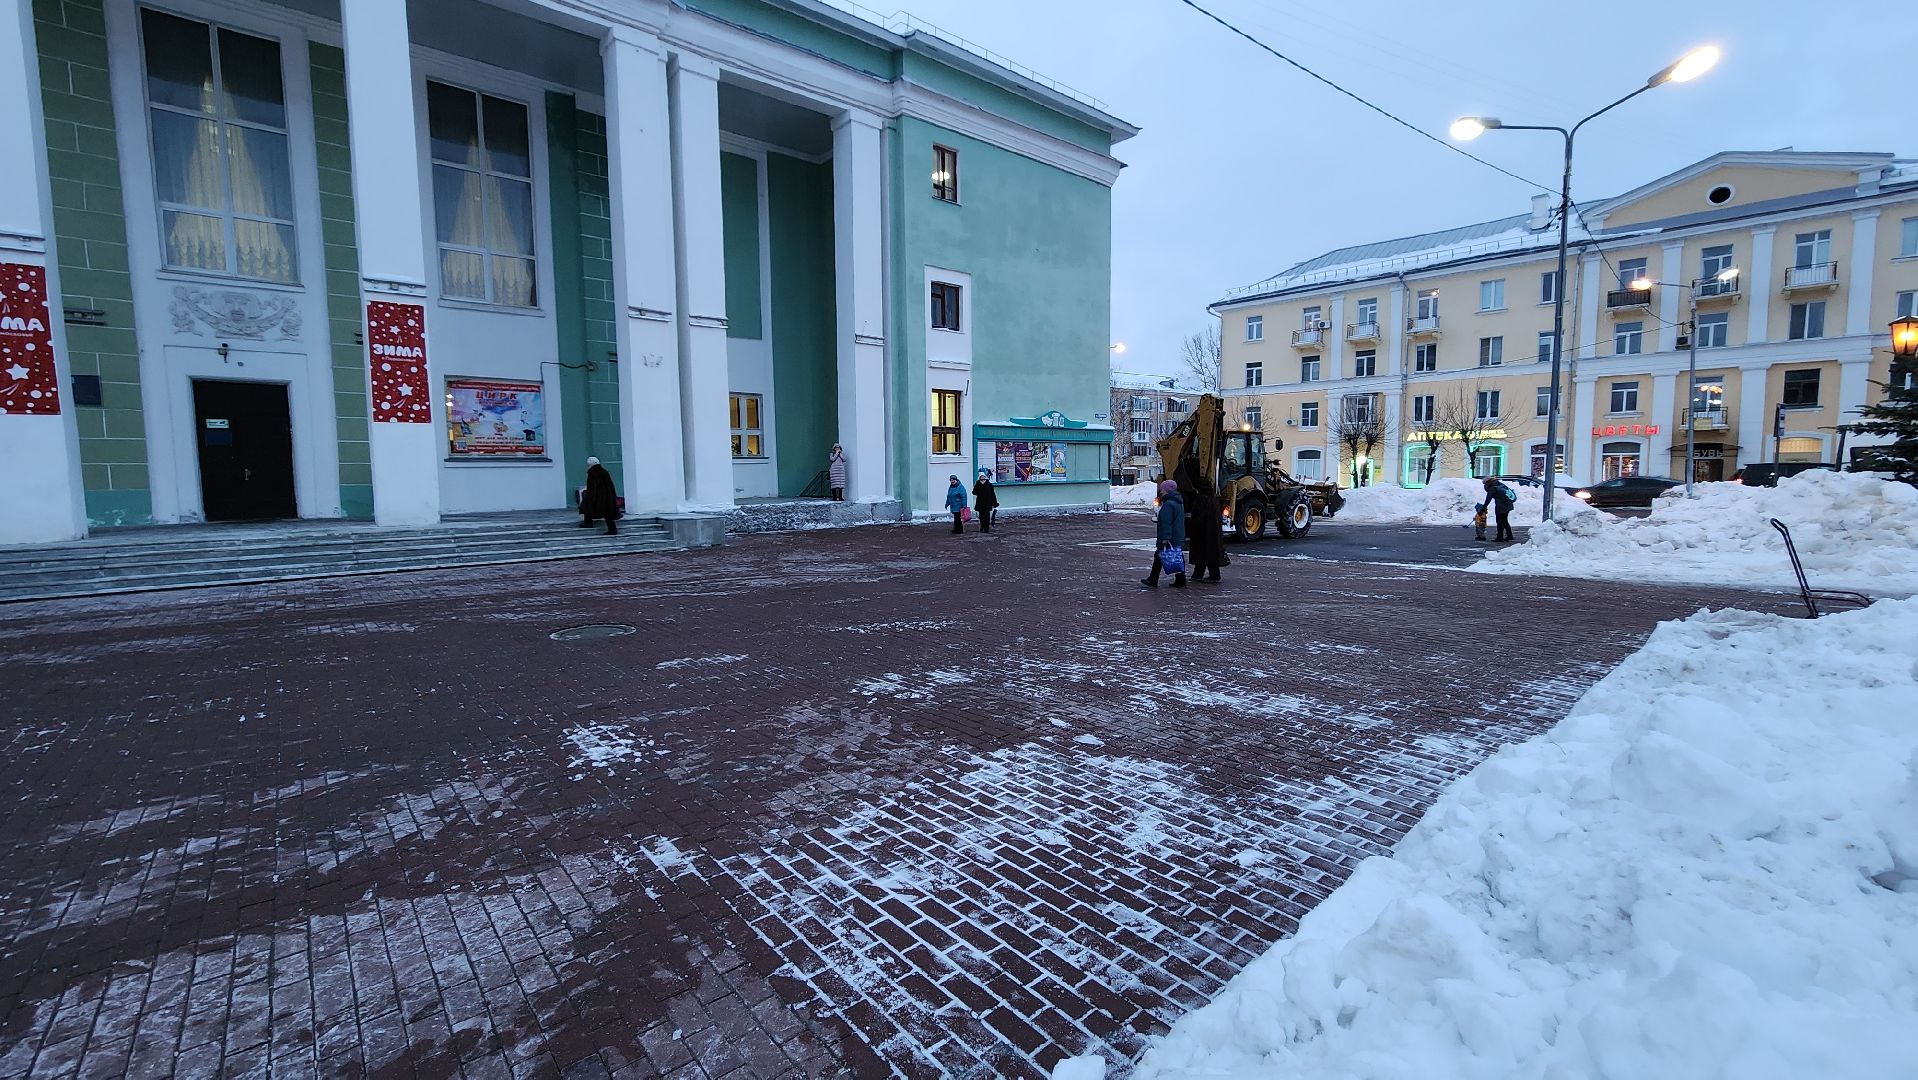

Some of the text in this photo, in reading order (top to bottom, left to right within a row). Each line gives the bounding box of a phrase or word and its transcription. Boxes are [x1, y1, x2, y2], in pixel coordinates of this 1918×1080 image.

[372, 343, 424, 358] ЗИМА
[475, 391, 518, 400] ЦИРК
[1407, 430, 1463, 442] АПТЕКА
[1592, 424, 1660, 437] ЦВЕТЫ
[1693, 449, 1724, 458] БУВЬ
